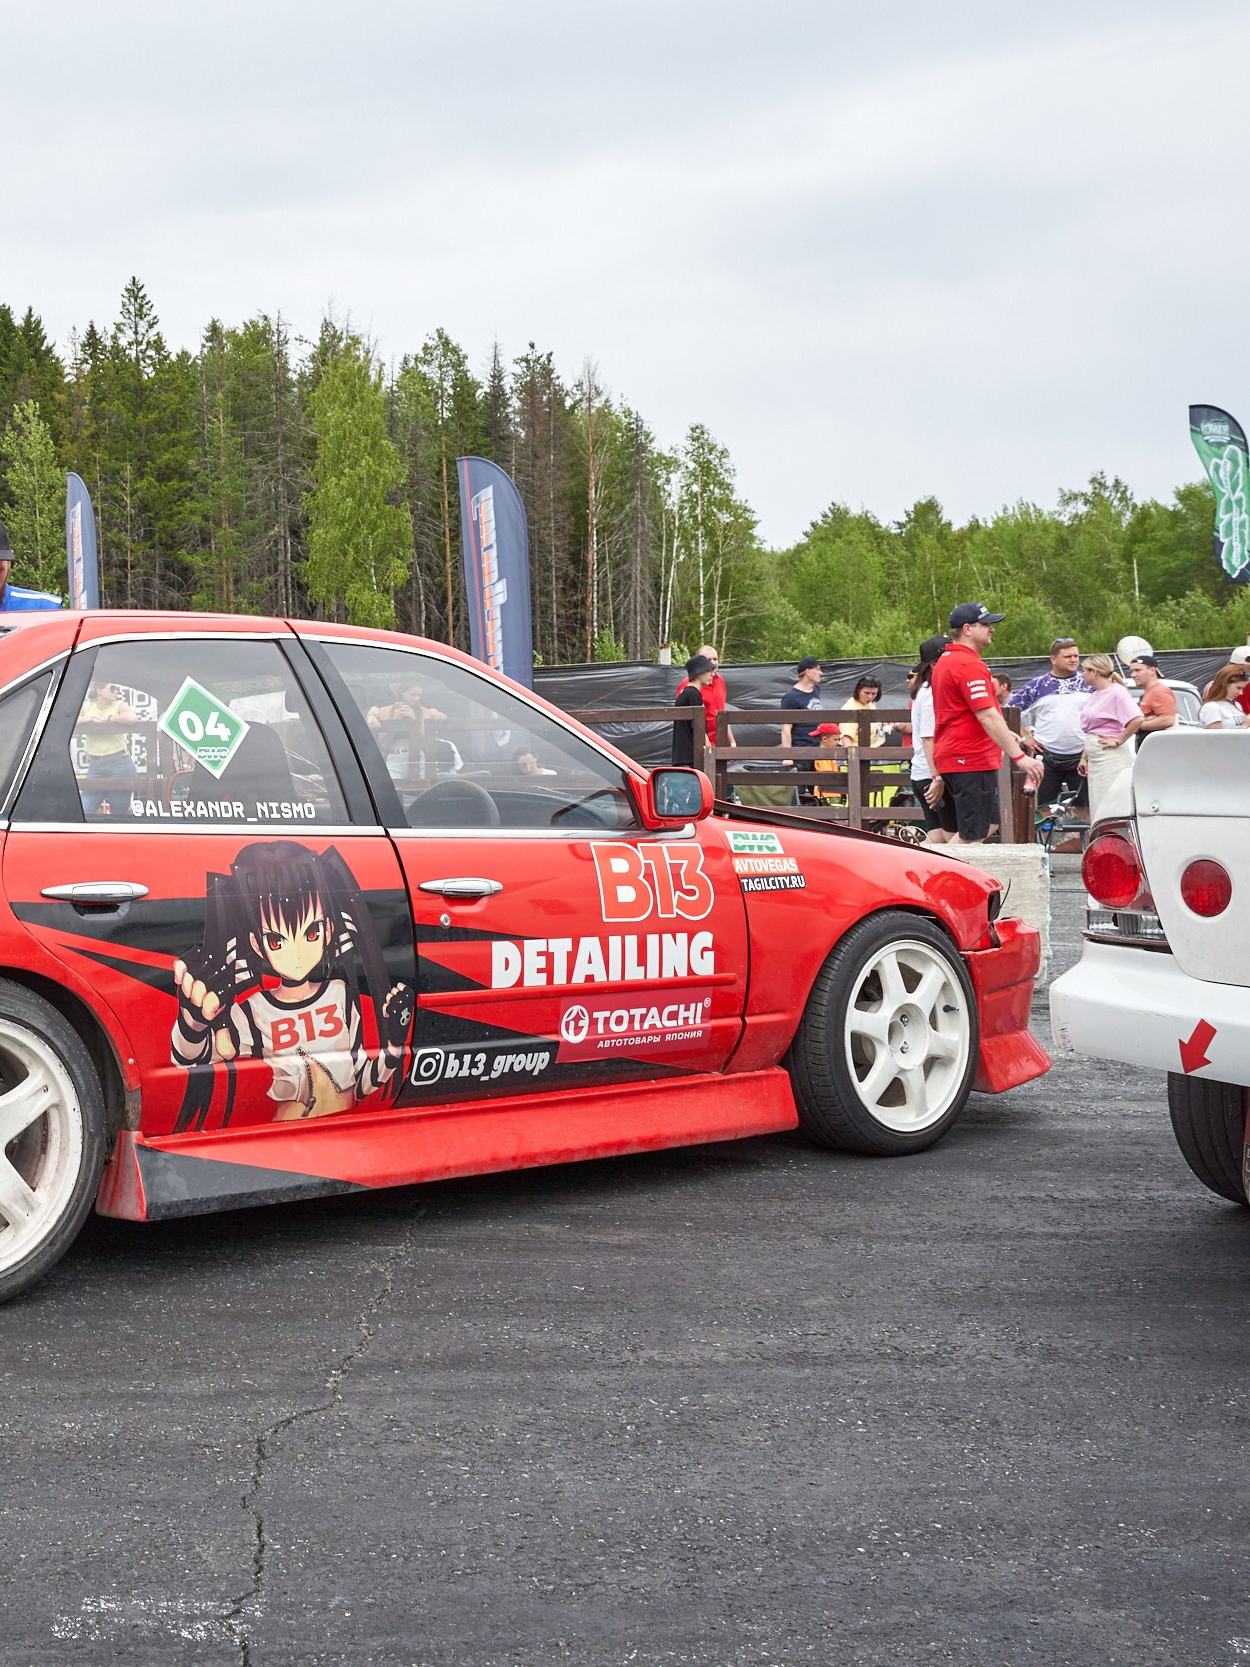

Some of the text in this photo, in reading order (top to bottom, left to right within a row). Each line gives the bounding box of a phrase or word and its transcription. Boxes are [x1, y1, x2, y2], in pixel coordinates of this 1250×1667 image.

[178, 710, 231, 742] 04
[198, 747, 229, 761] DWC
[132, 800, 316, 822] @ALEXANDR_NISMO
[732, 832, 778, 852] DWC
[735, 858, 798, 873] AVTOVEGAS
[590, 842, 714, 922] B13
[741, 875, 806, 892] TAGILCITY.RU
[491, 931, 715, 989] DETAILING
[270, 1003, 344, 1052] B13
[597, 1030, 703, 1048] АВТОТОВАРЫ ЯПОНИЯ
[444, 1051, 550, 1081] b13_group
